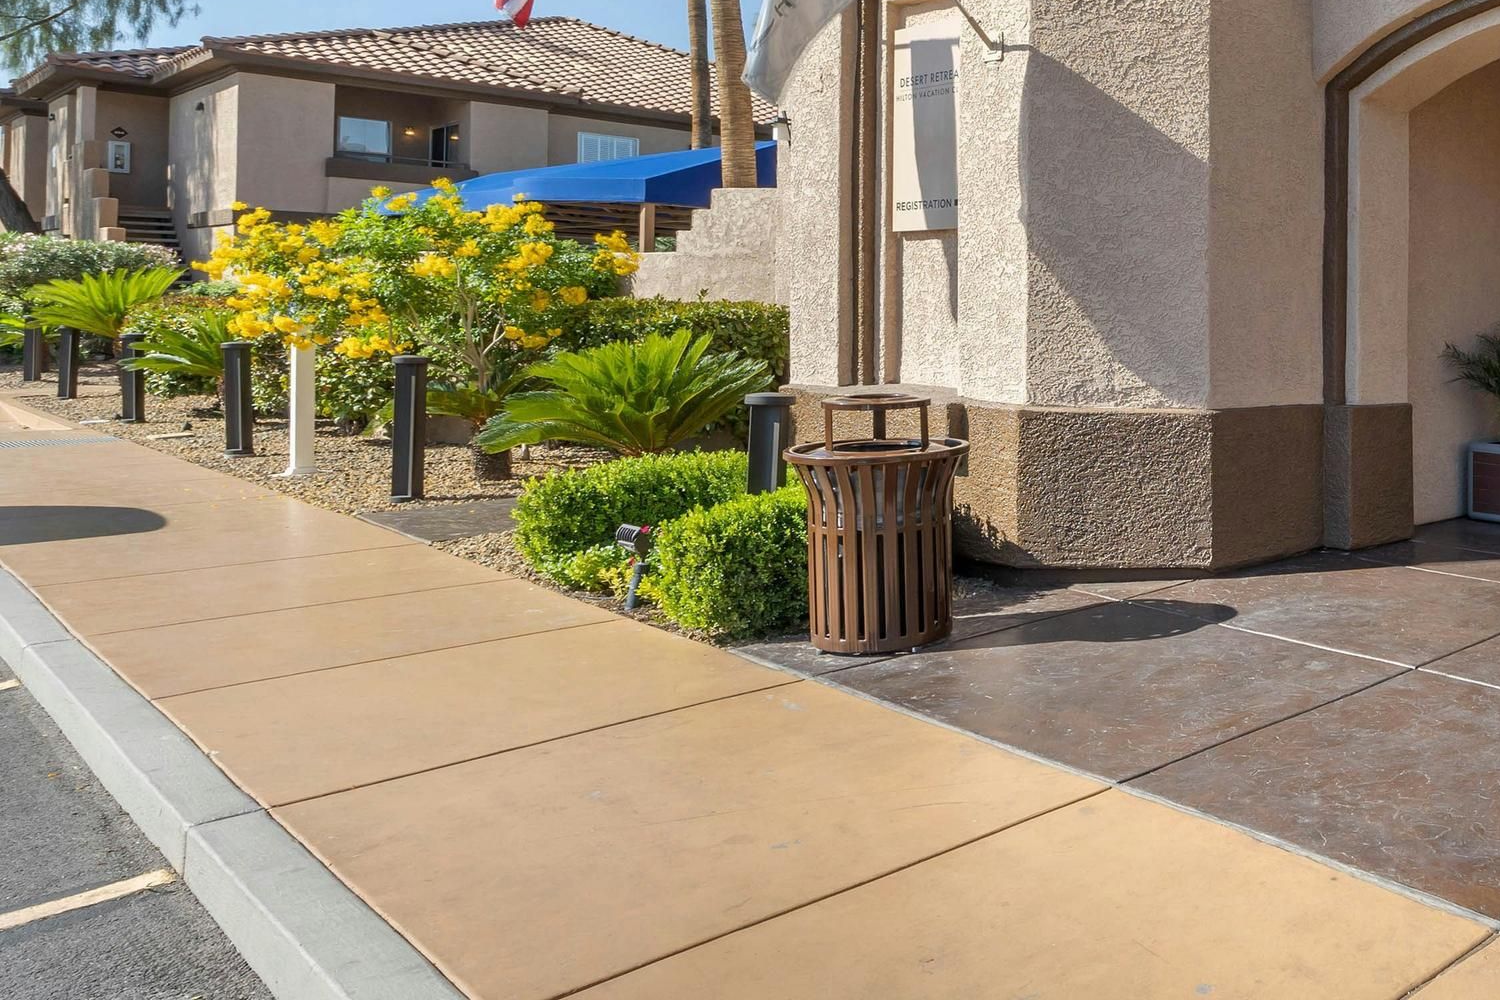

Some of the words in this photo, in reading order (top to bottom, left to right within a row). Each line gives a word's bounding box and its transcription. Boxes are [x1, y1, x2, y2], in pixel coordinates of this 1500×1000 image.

[900, 73, 928, 88] DESERT
[930, 69, 960, 83] RETREA
[919, 87, 950, 99] VACATION
[896, 199, 952, 212] REGISTRATION
